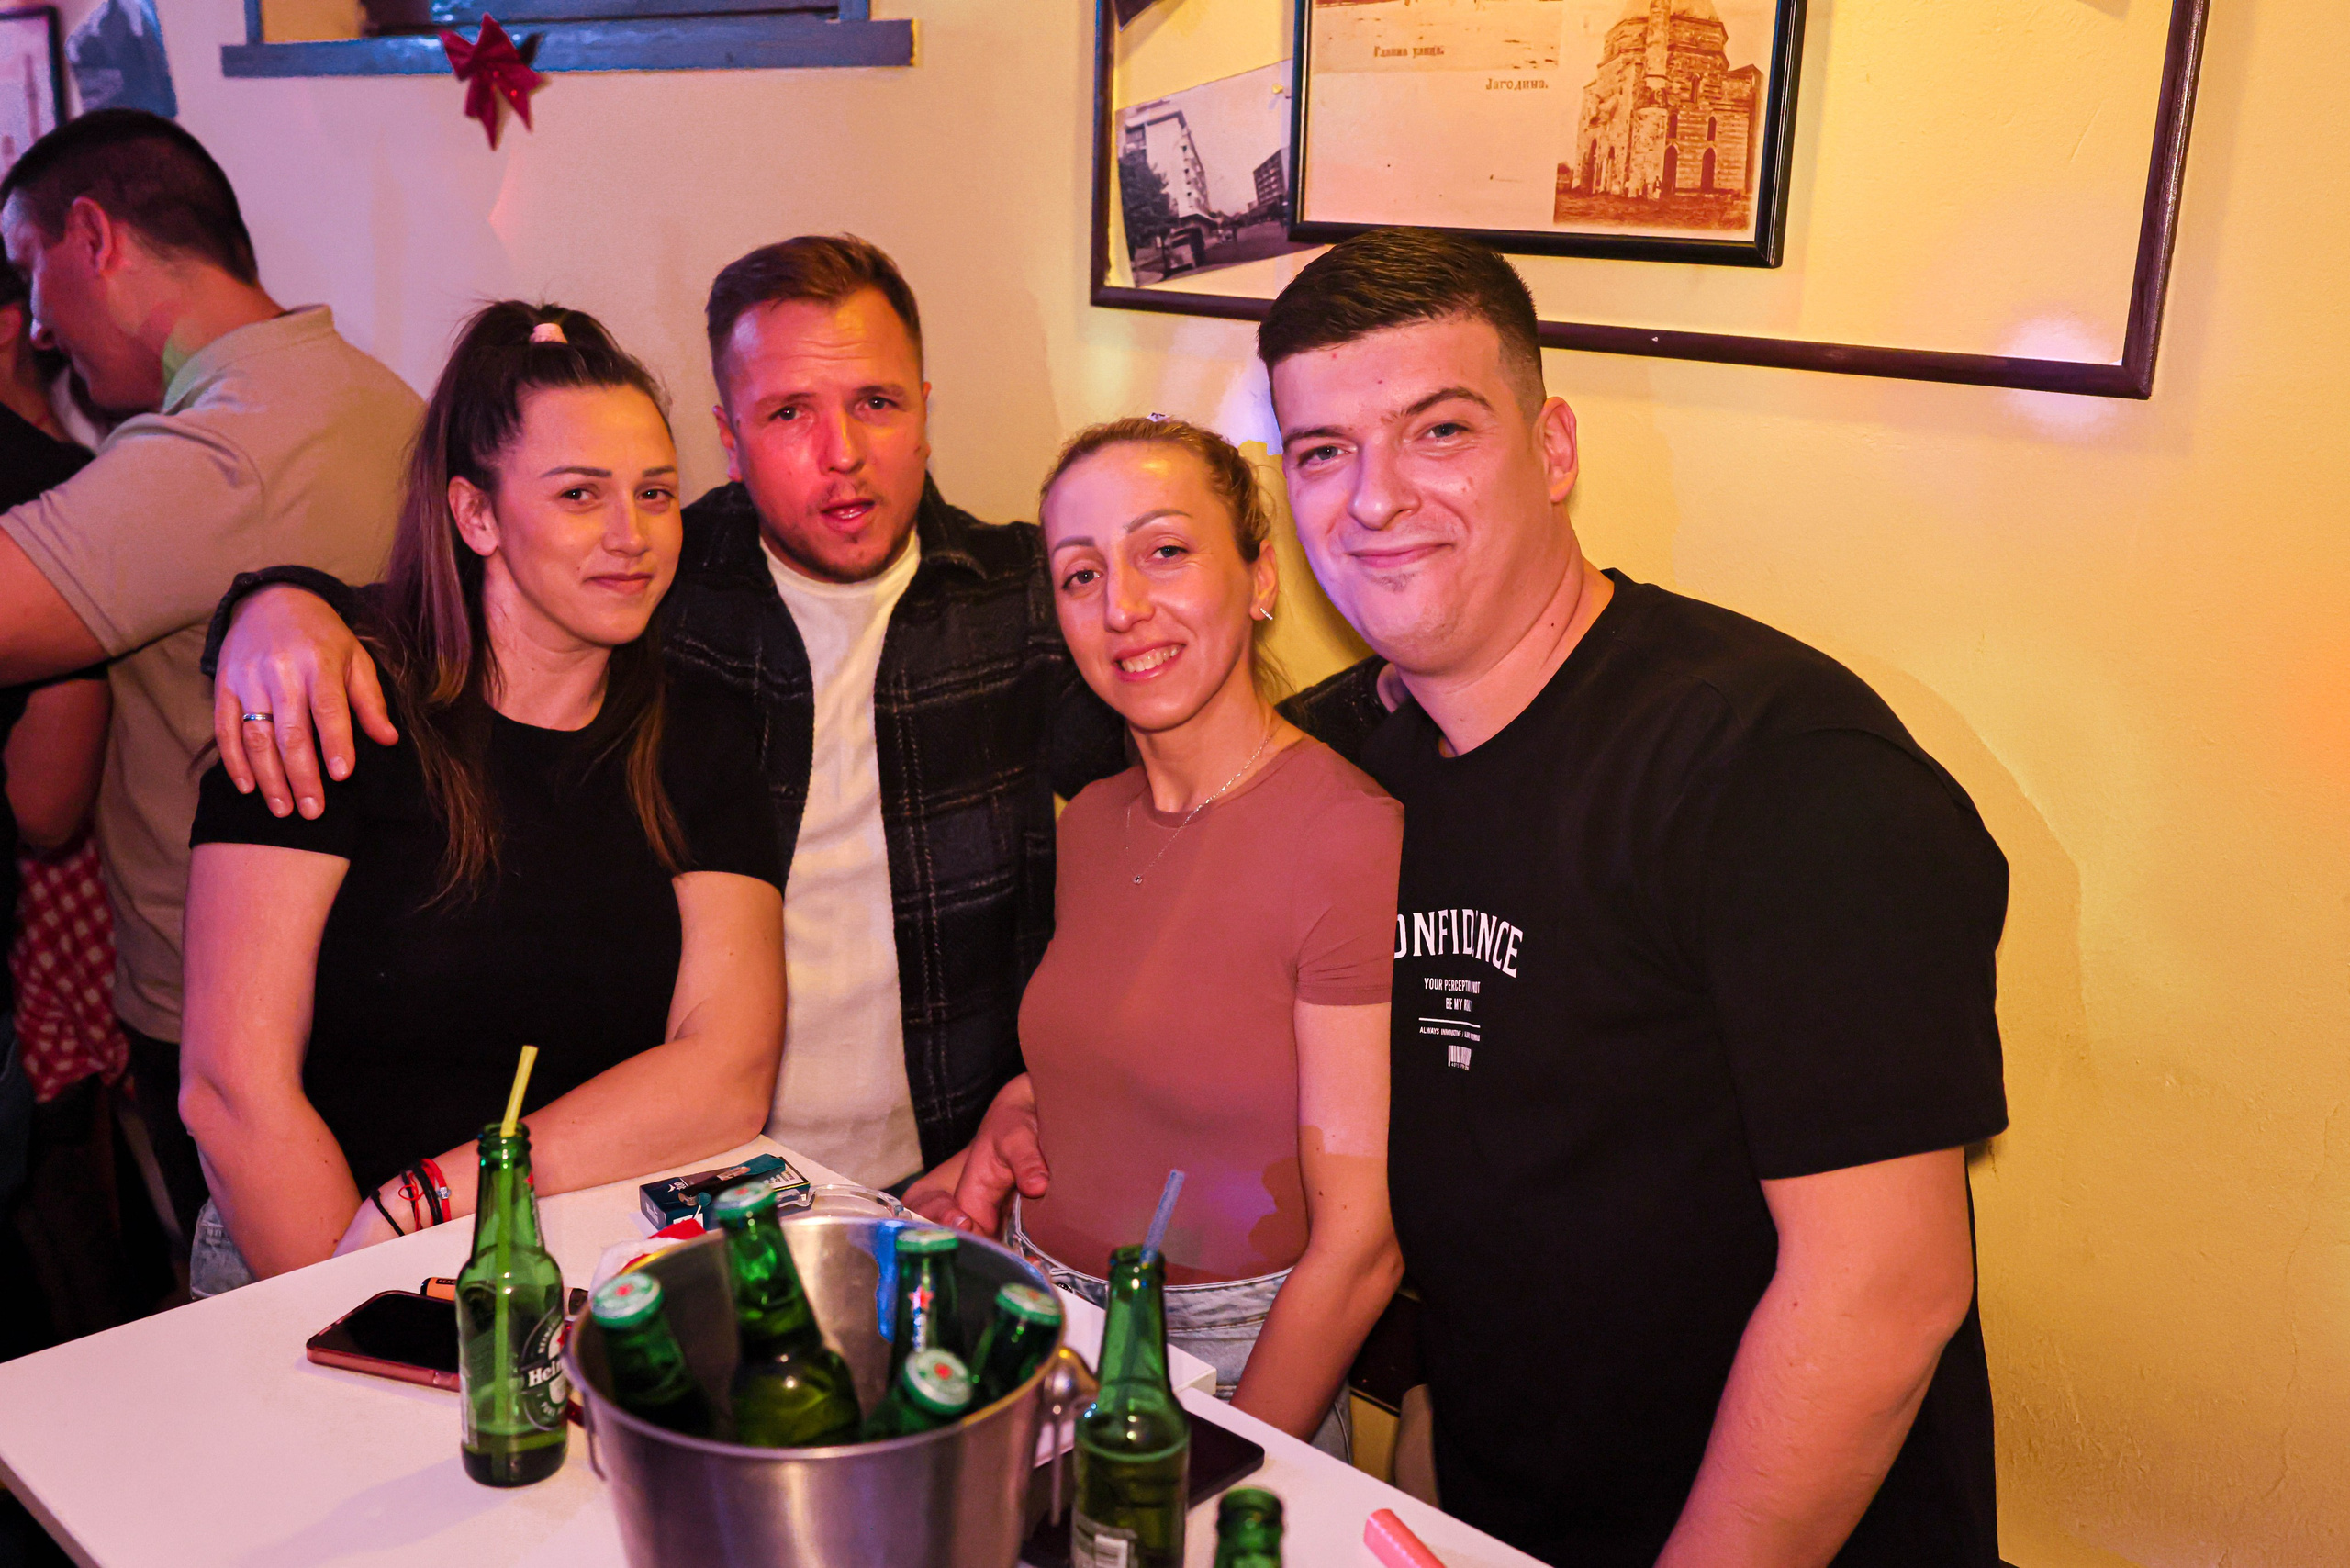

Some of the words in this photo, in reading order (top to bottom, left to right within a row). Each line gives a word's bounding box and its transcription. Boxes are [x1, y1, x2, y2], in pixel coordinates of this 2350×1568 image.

[1393, 909, 1524, 979] ONFIDNCE
[1424, 977, 1443, 991] YOUR
[1445, 997, 1453, 1010] BE
[1453, 998, 1463, 1011] MY
[1419, 1026, 1440, 1035] ALWAYS
